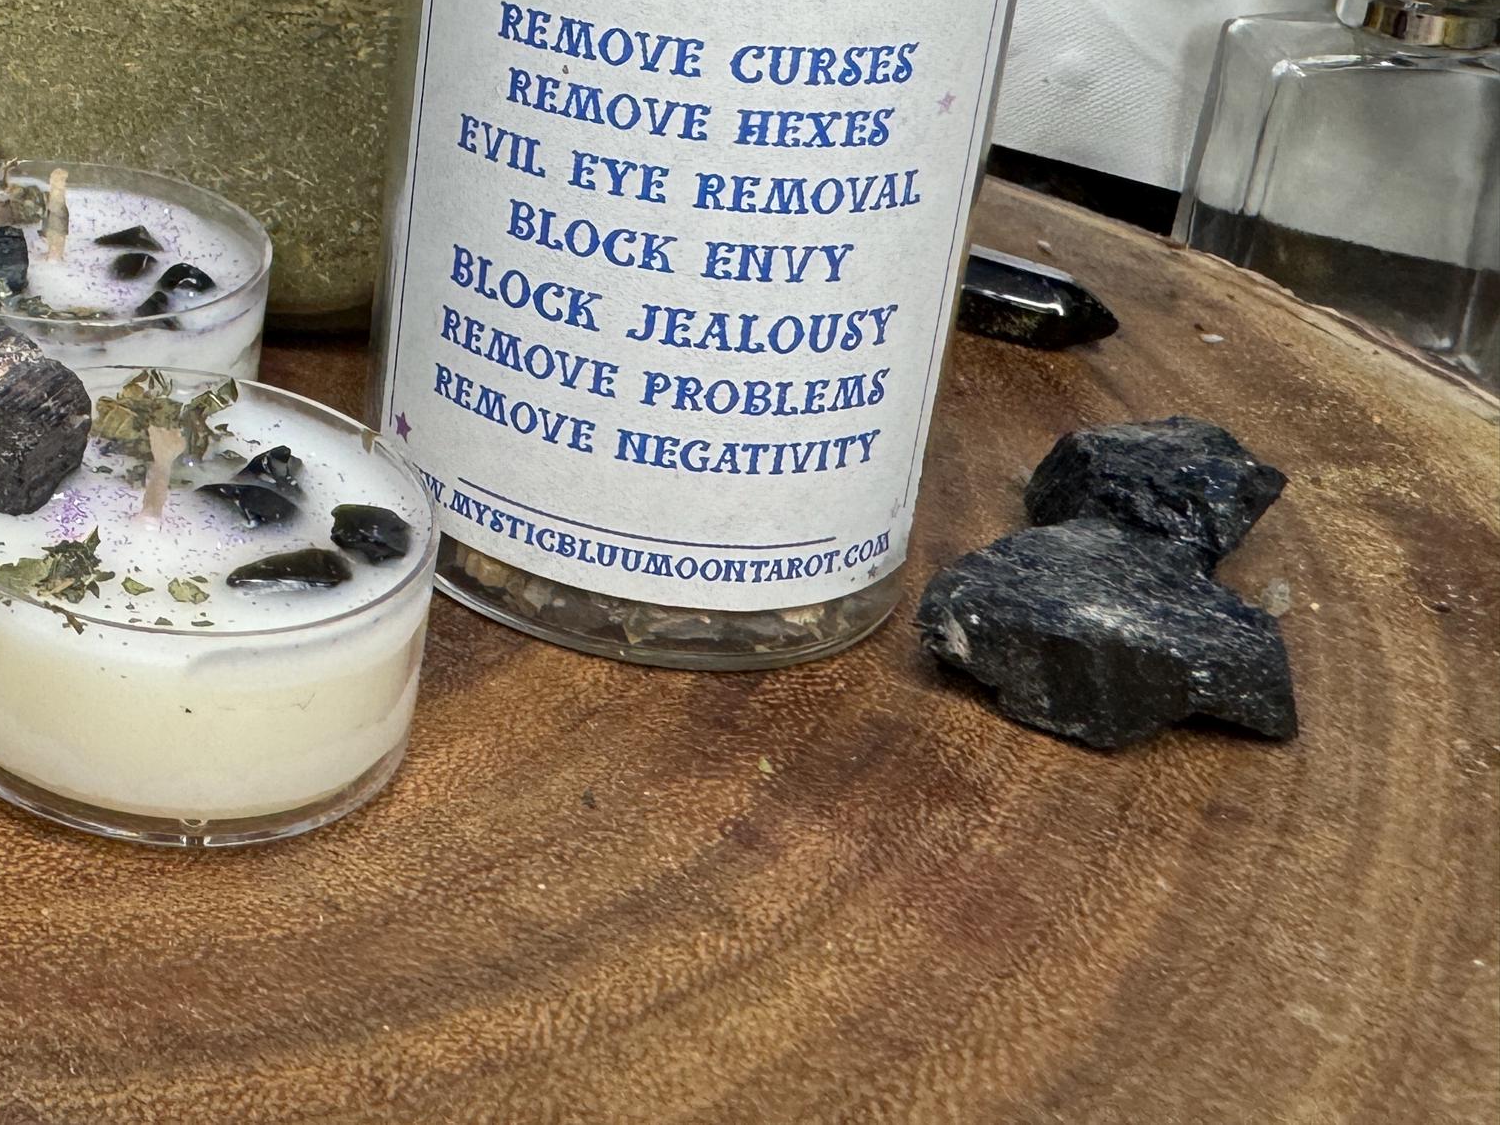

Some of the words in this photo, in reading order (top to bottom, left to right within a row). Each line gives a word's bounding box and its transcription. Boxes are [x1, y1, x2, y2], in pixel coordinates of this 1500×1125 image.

[499, 2, 705, 78] REMOVE
[729, 42, 918, 87] CURSES
[507, 67, 712, 142] REMOVE
[735, 107, 895, 148] HEXES
[459, 114, 546, 178] EVIL
[569, 150, 670, 204] EYE
[693, 170, 921, 215] REMOVAL
[508, 199, 674, 274] BLOCK
[702, 241, 854, 284] ENVY
[451, 245, 601, 332] BLOCK
[626, 303, 896, 355] JEALOUSY
[441, 306, 619, 398] REMOVE
[643, 369, 889, 416] PROBLEMS
[434, 364, 597, 453] REMOVE
[616, 428, 880, 476] NEGATIVITY
